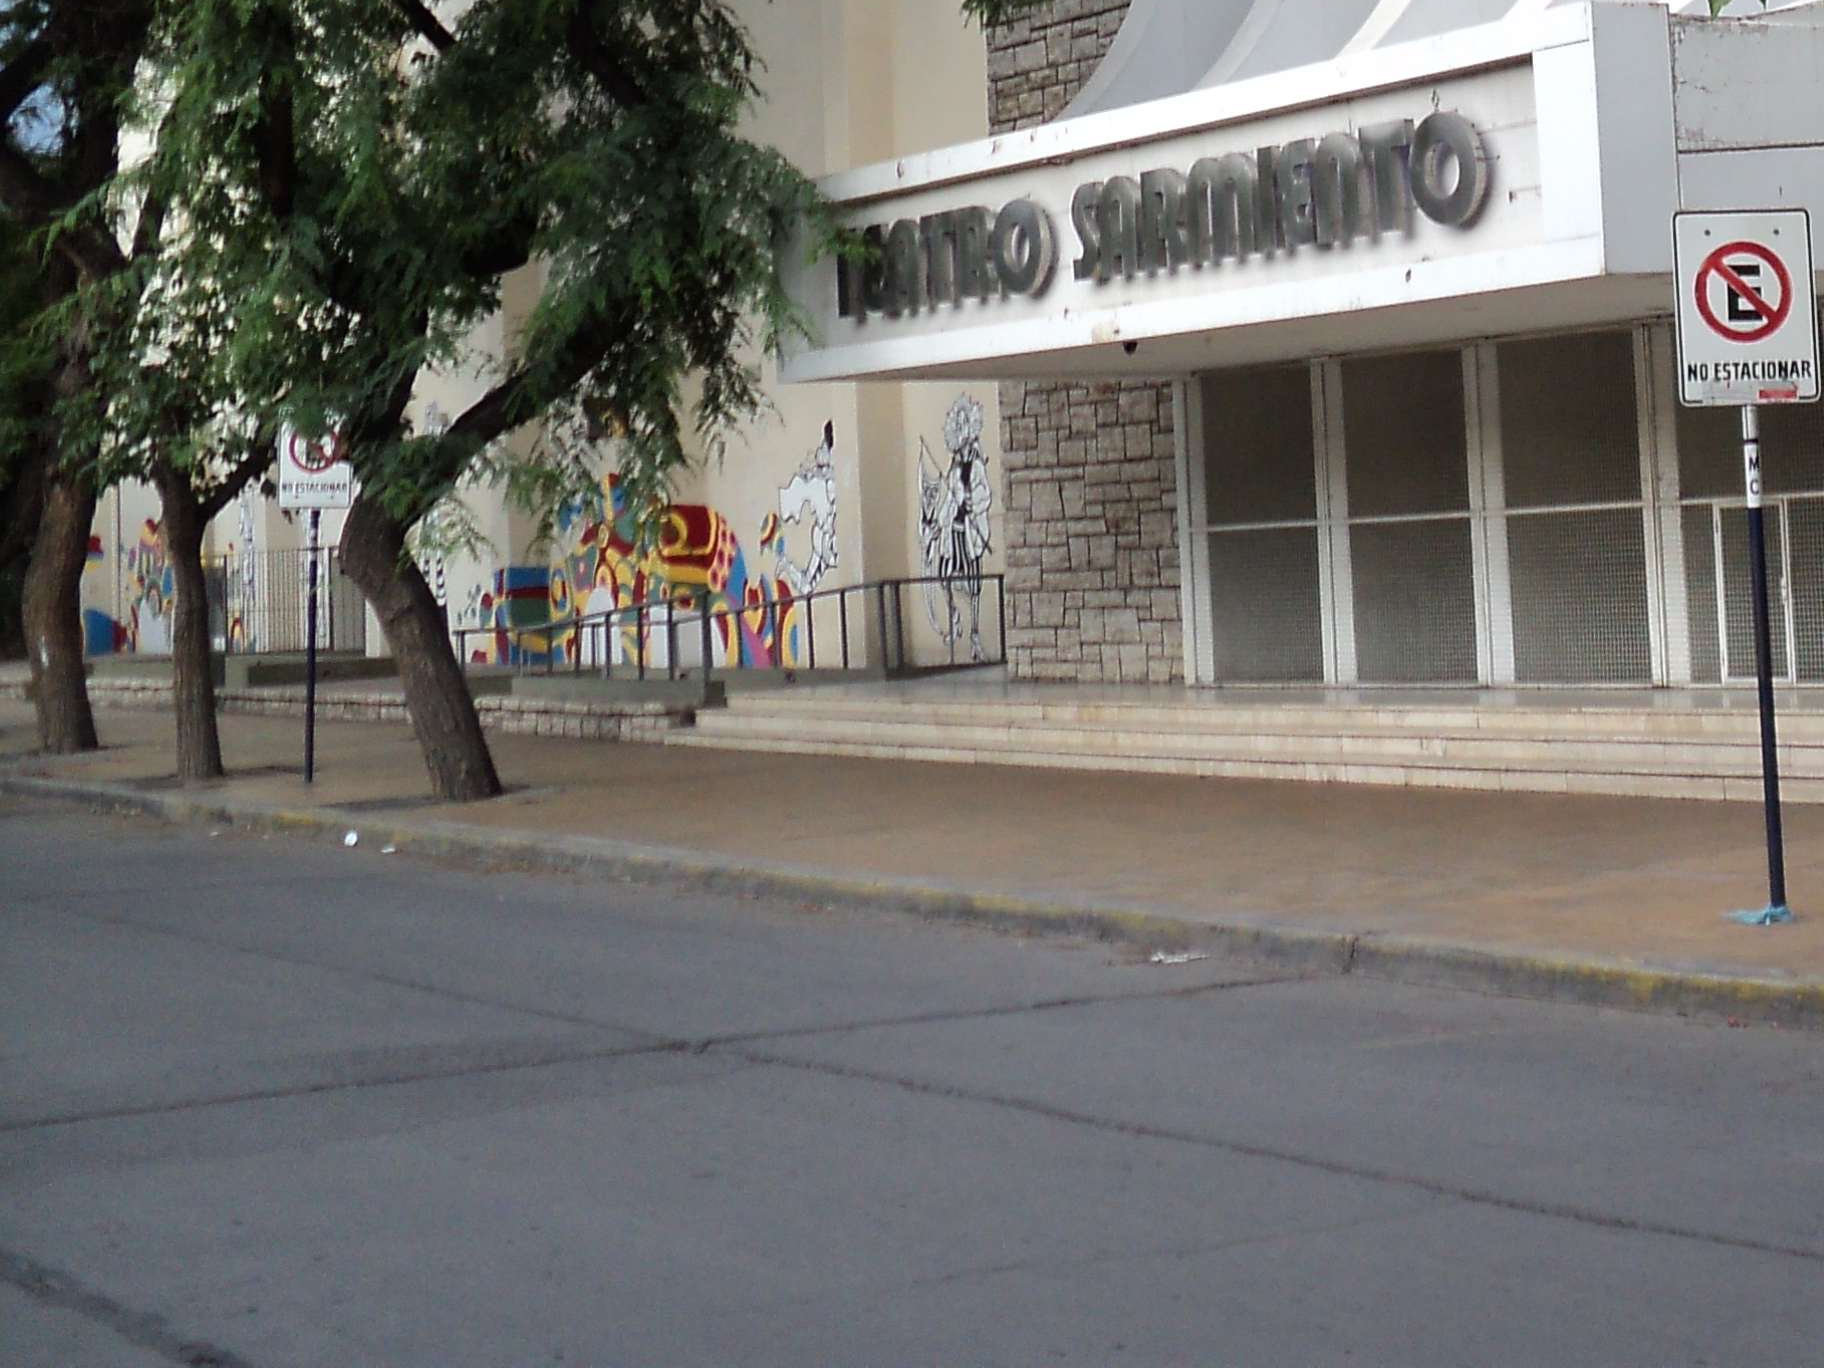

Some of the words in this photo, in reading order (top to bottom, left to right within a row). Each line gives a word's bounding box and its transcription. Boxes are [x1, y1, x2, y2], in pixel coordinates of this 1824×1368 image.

[1071, 111, 1486, 282] SARMIENTO
[1687, 363, 1708, 382] NO
[1714, 360, 1812, 381] ESTACIONAR
